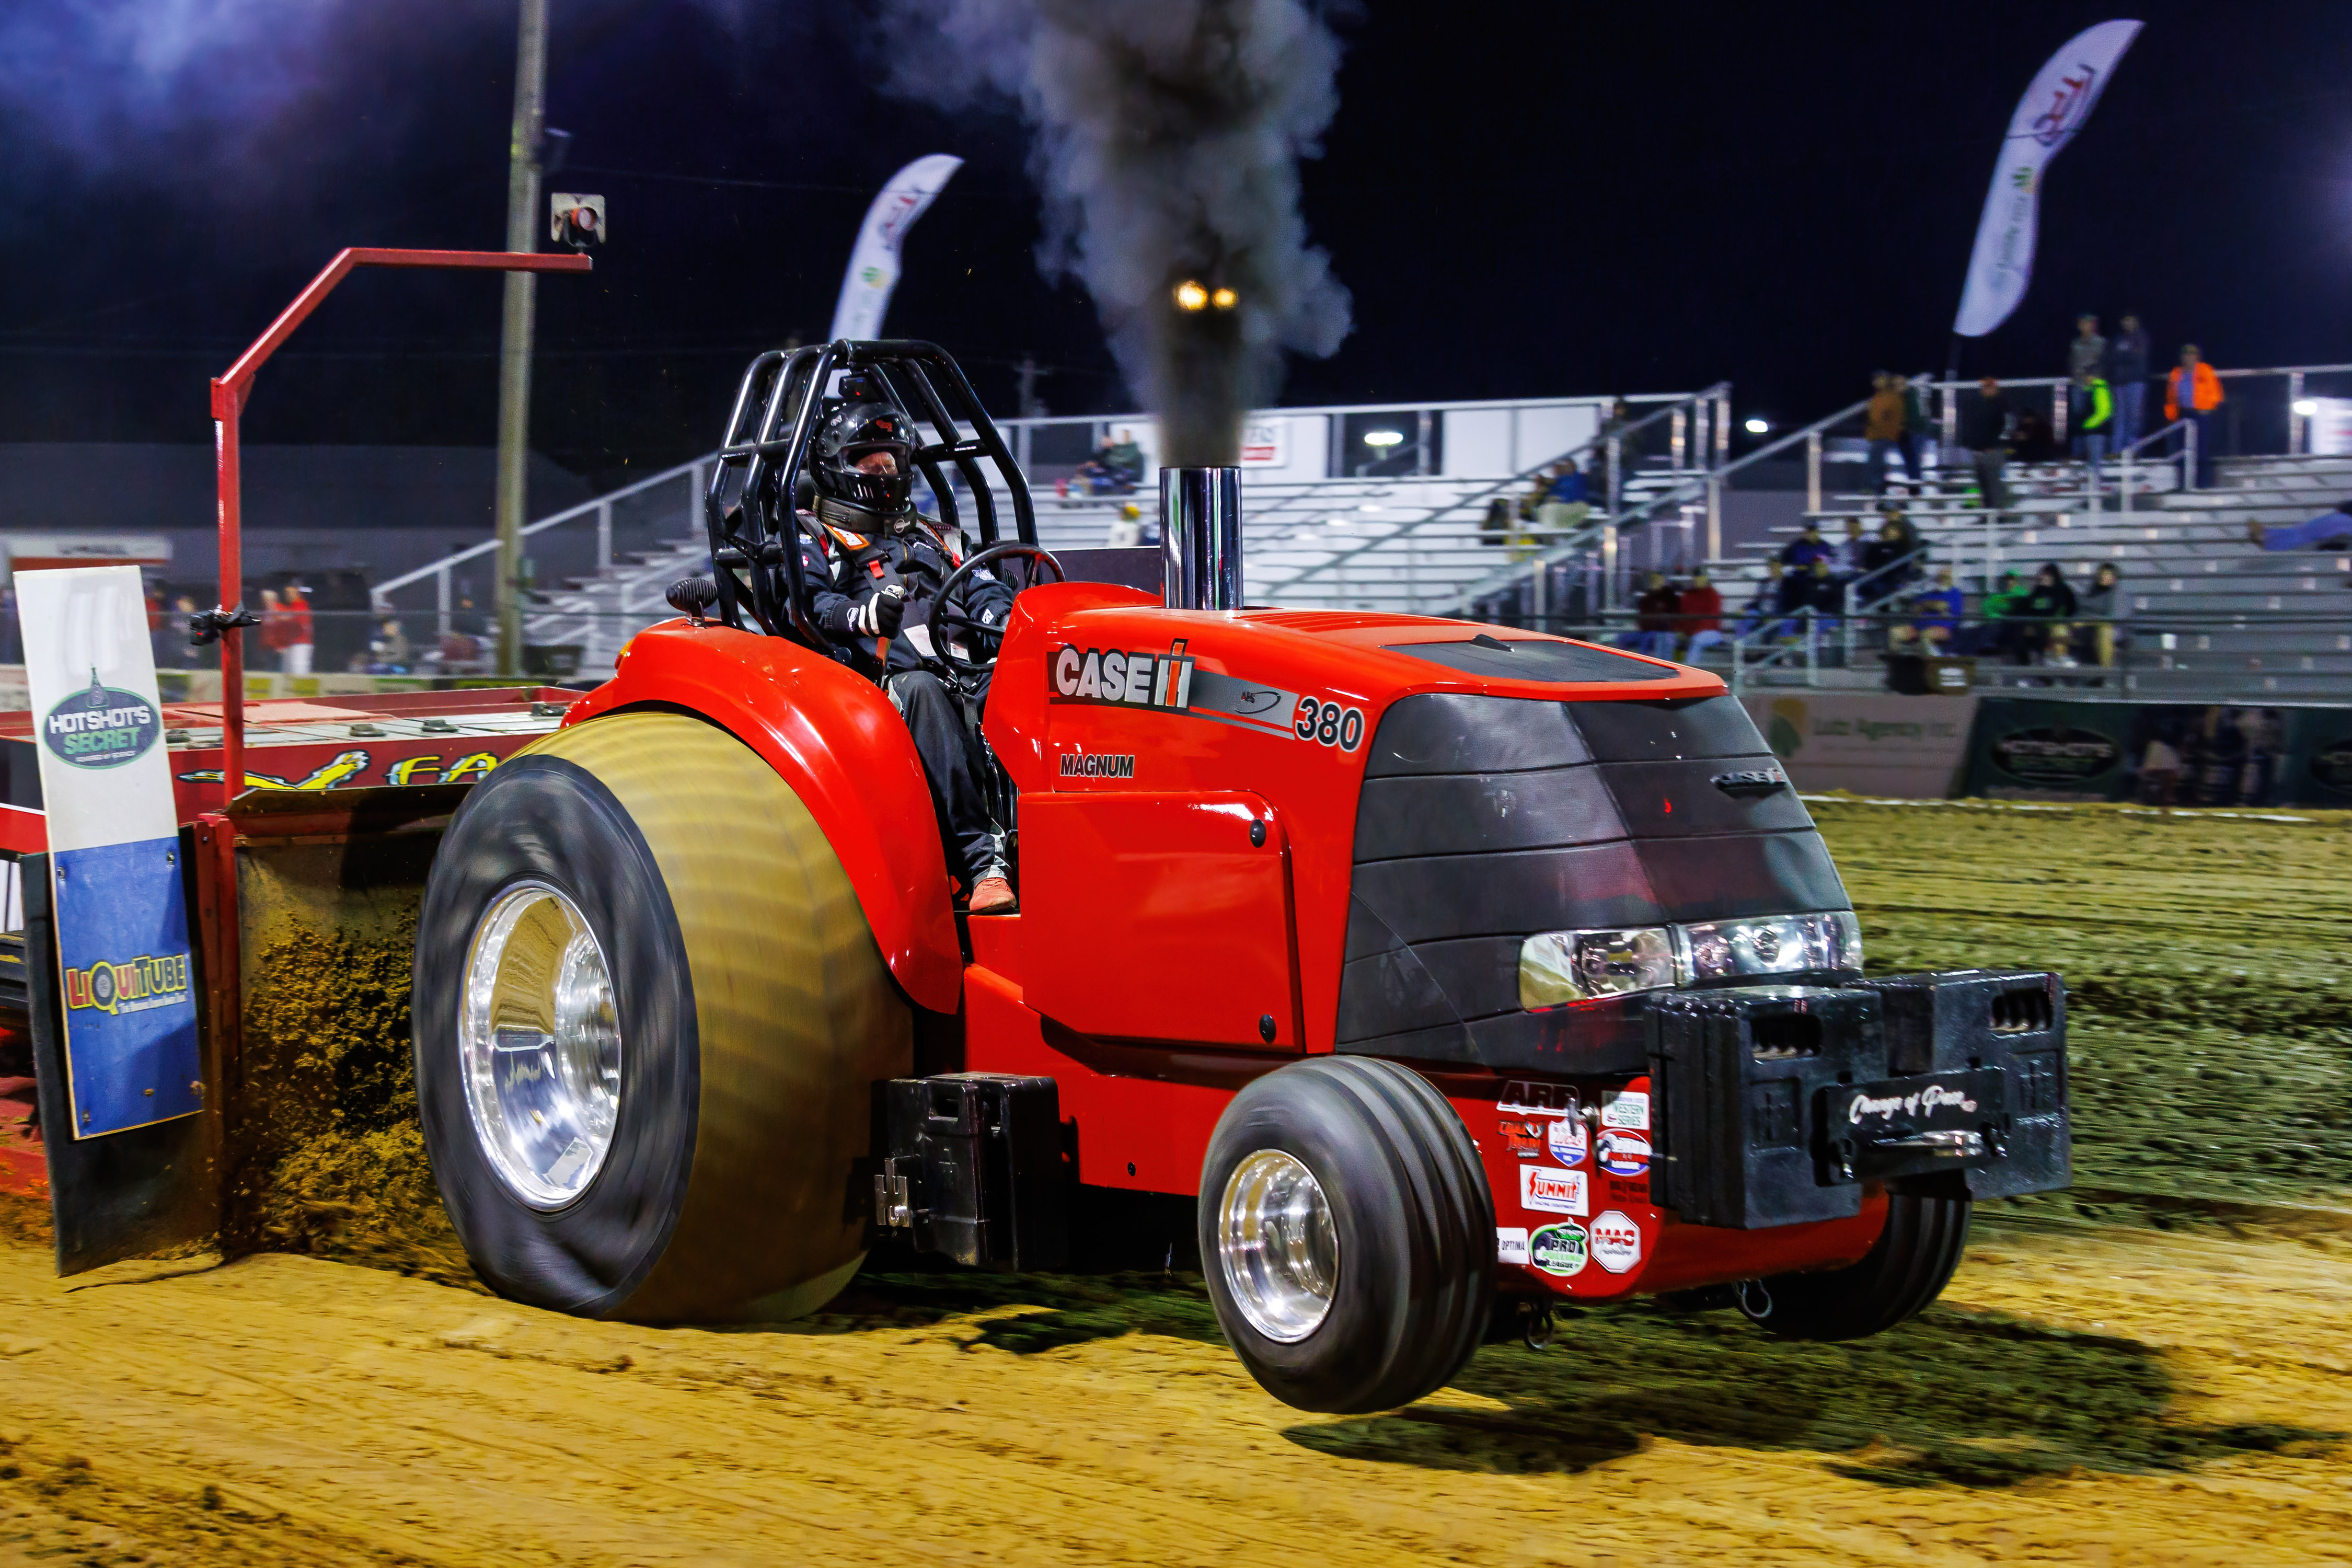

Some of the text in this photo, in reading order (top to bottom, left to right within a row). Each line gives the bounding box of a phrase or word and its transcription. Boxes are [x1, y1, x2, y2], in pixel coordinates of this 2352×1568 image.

[1055, 648, 1152, 704] CASE
[1295, 695, 1365, 753] 380
[64, 727, 141, 755] SECRET
[1060, 753, 1135, 778] MAGNUM
[1502, 1241, 1525, 1251] OPTIMA
[1550, 1237, 1579, 1254] PRO
